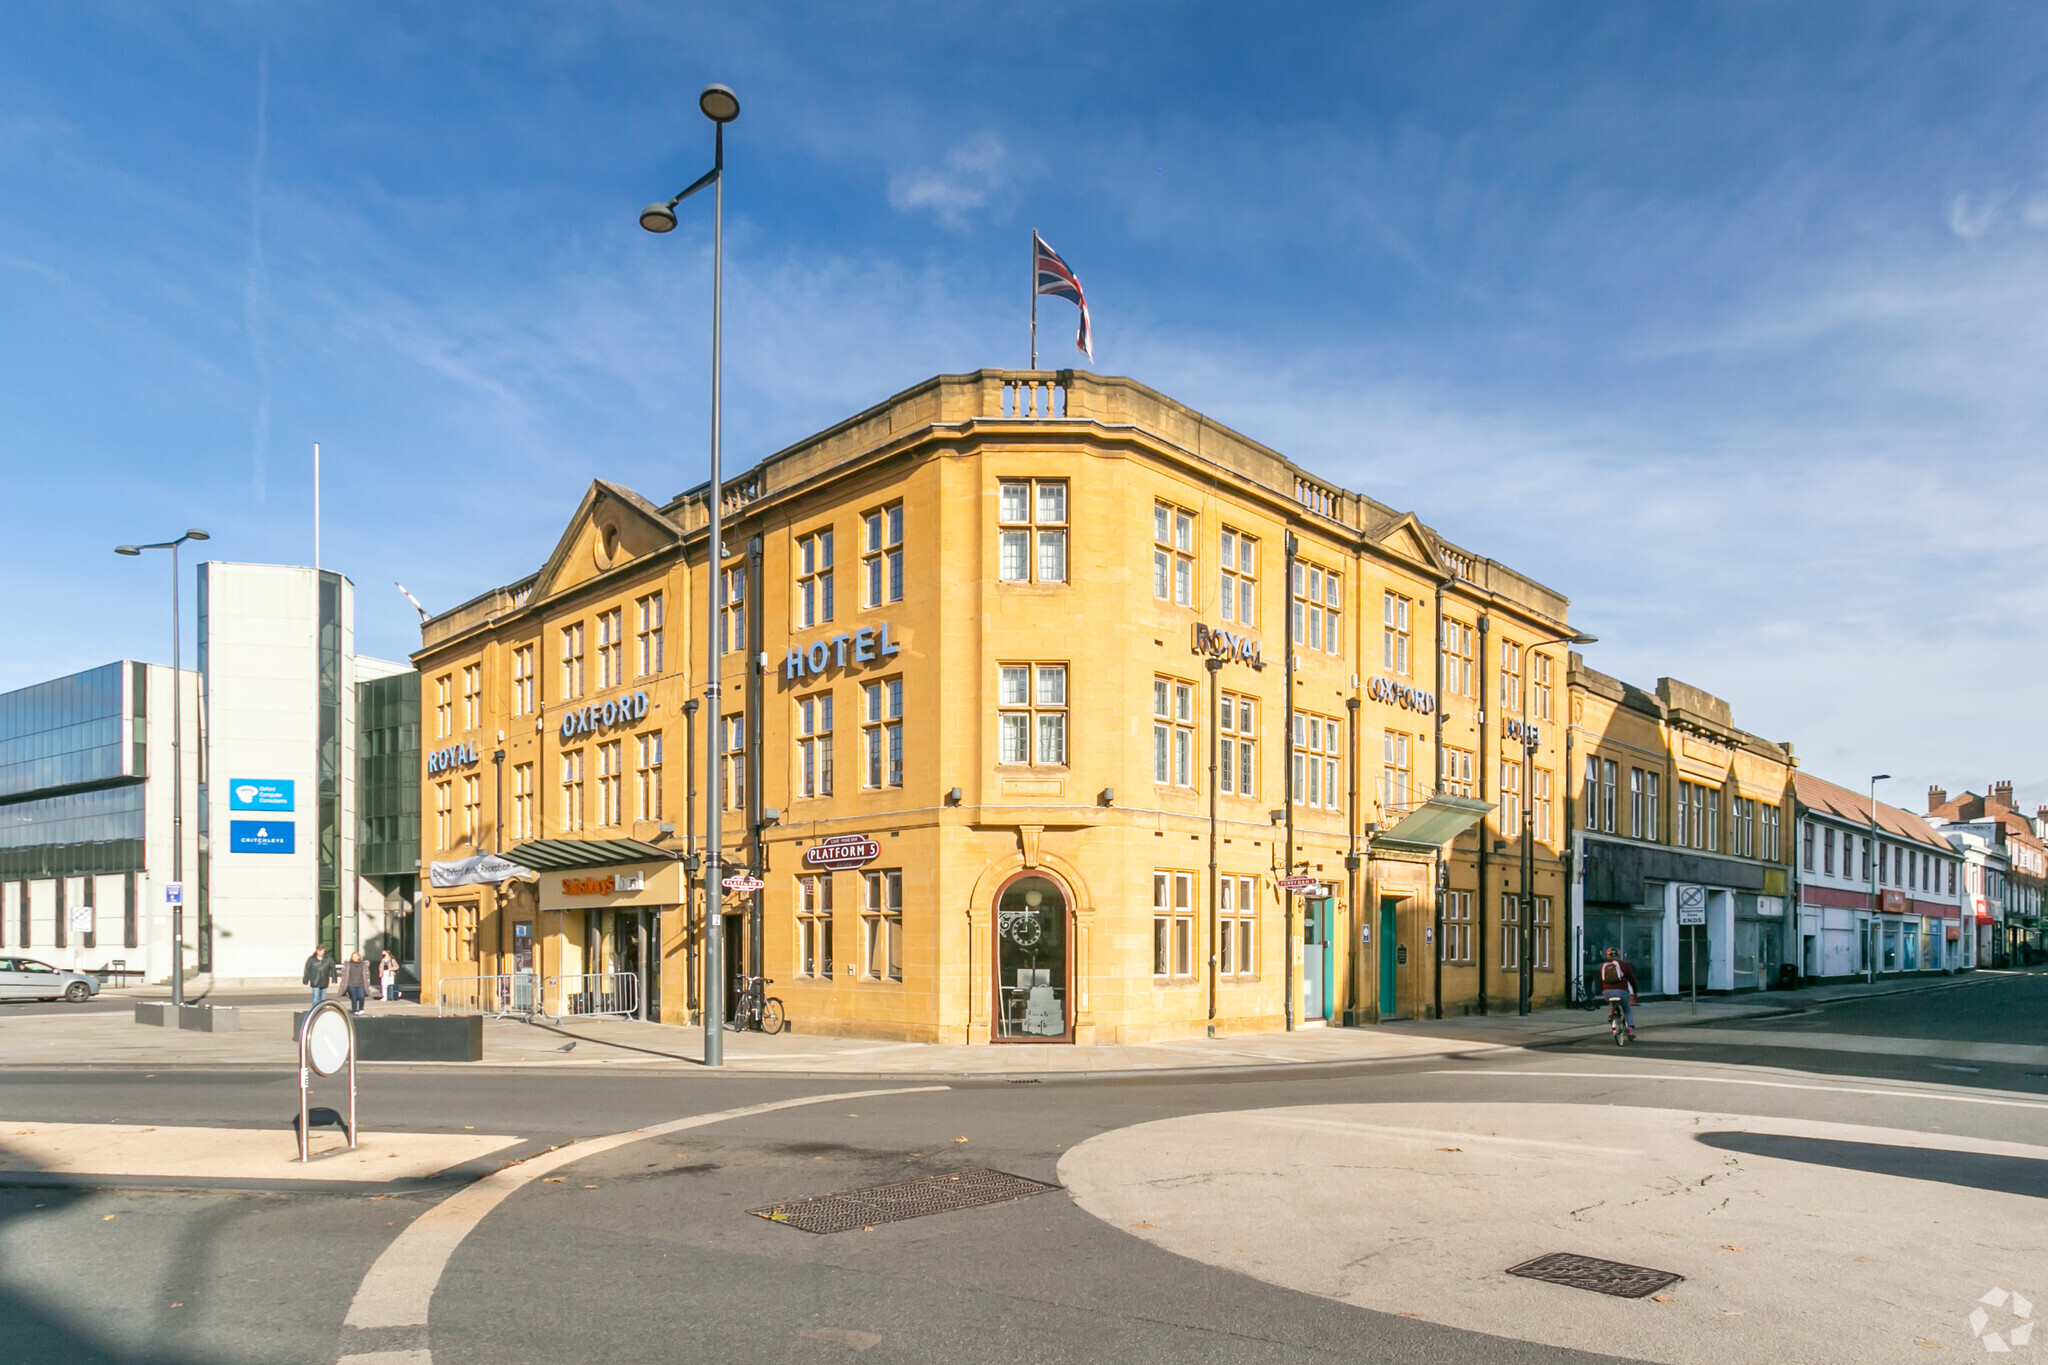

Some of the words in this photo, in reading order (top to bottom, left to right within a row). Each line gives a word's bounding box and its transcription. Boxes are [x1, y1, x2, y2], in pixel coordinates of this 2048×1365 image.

[786, 621, 901, 680] HOTEL
[1193, 622, 1267, 669] ROYAL
[1369, 676, 1436, 714] OXFORD
[561, 690, 649, 738] OXFORD
[428, 740, 478, 774] ROYAL
[480, 864, 511, 875] Reception
[810, 845, 865, 860] PLATFORM
[870, 844, 876, 855] 5
[562, 875, 615, 896] Sainsbury's
